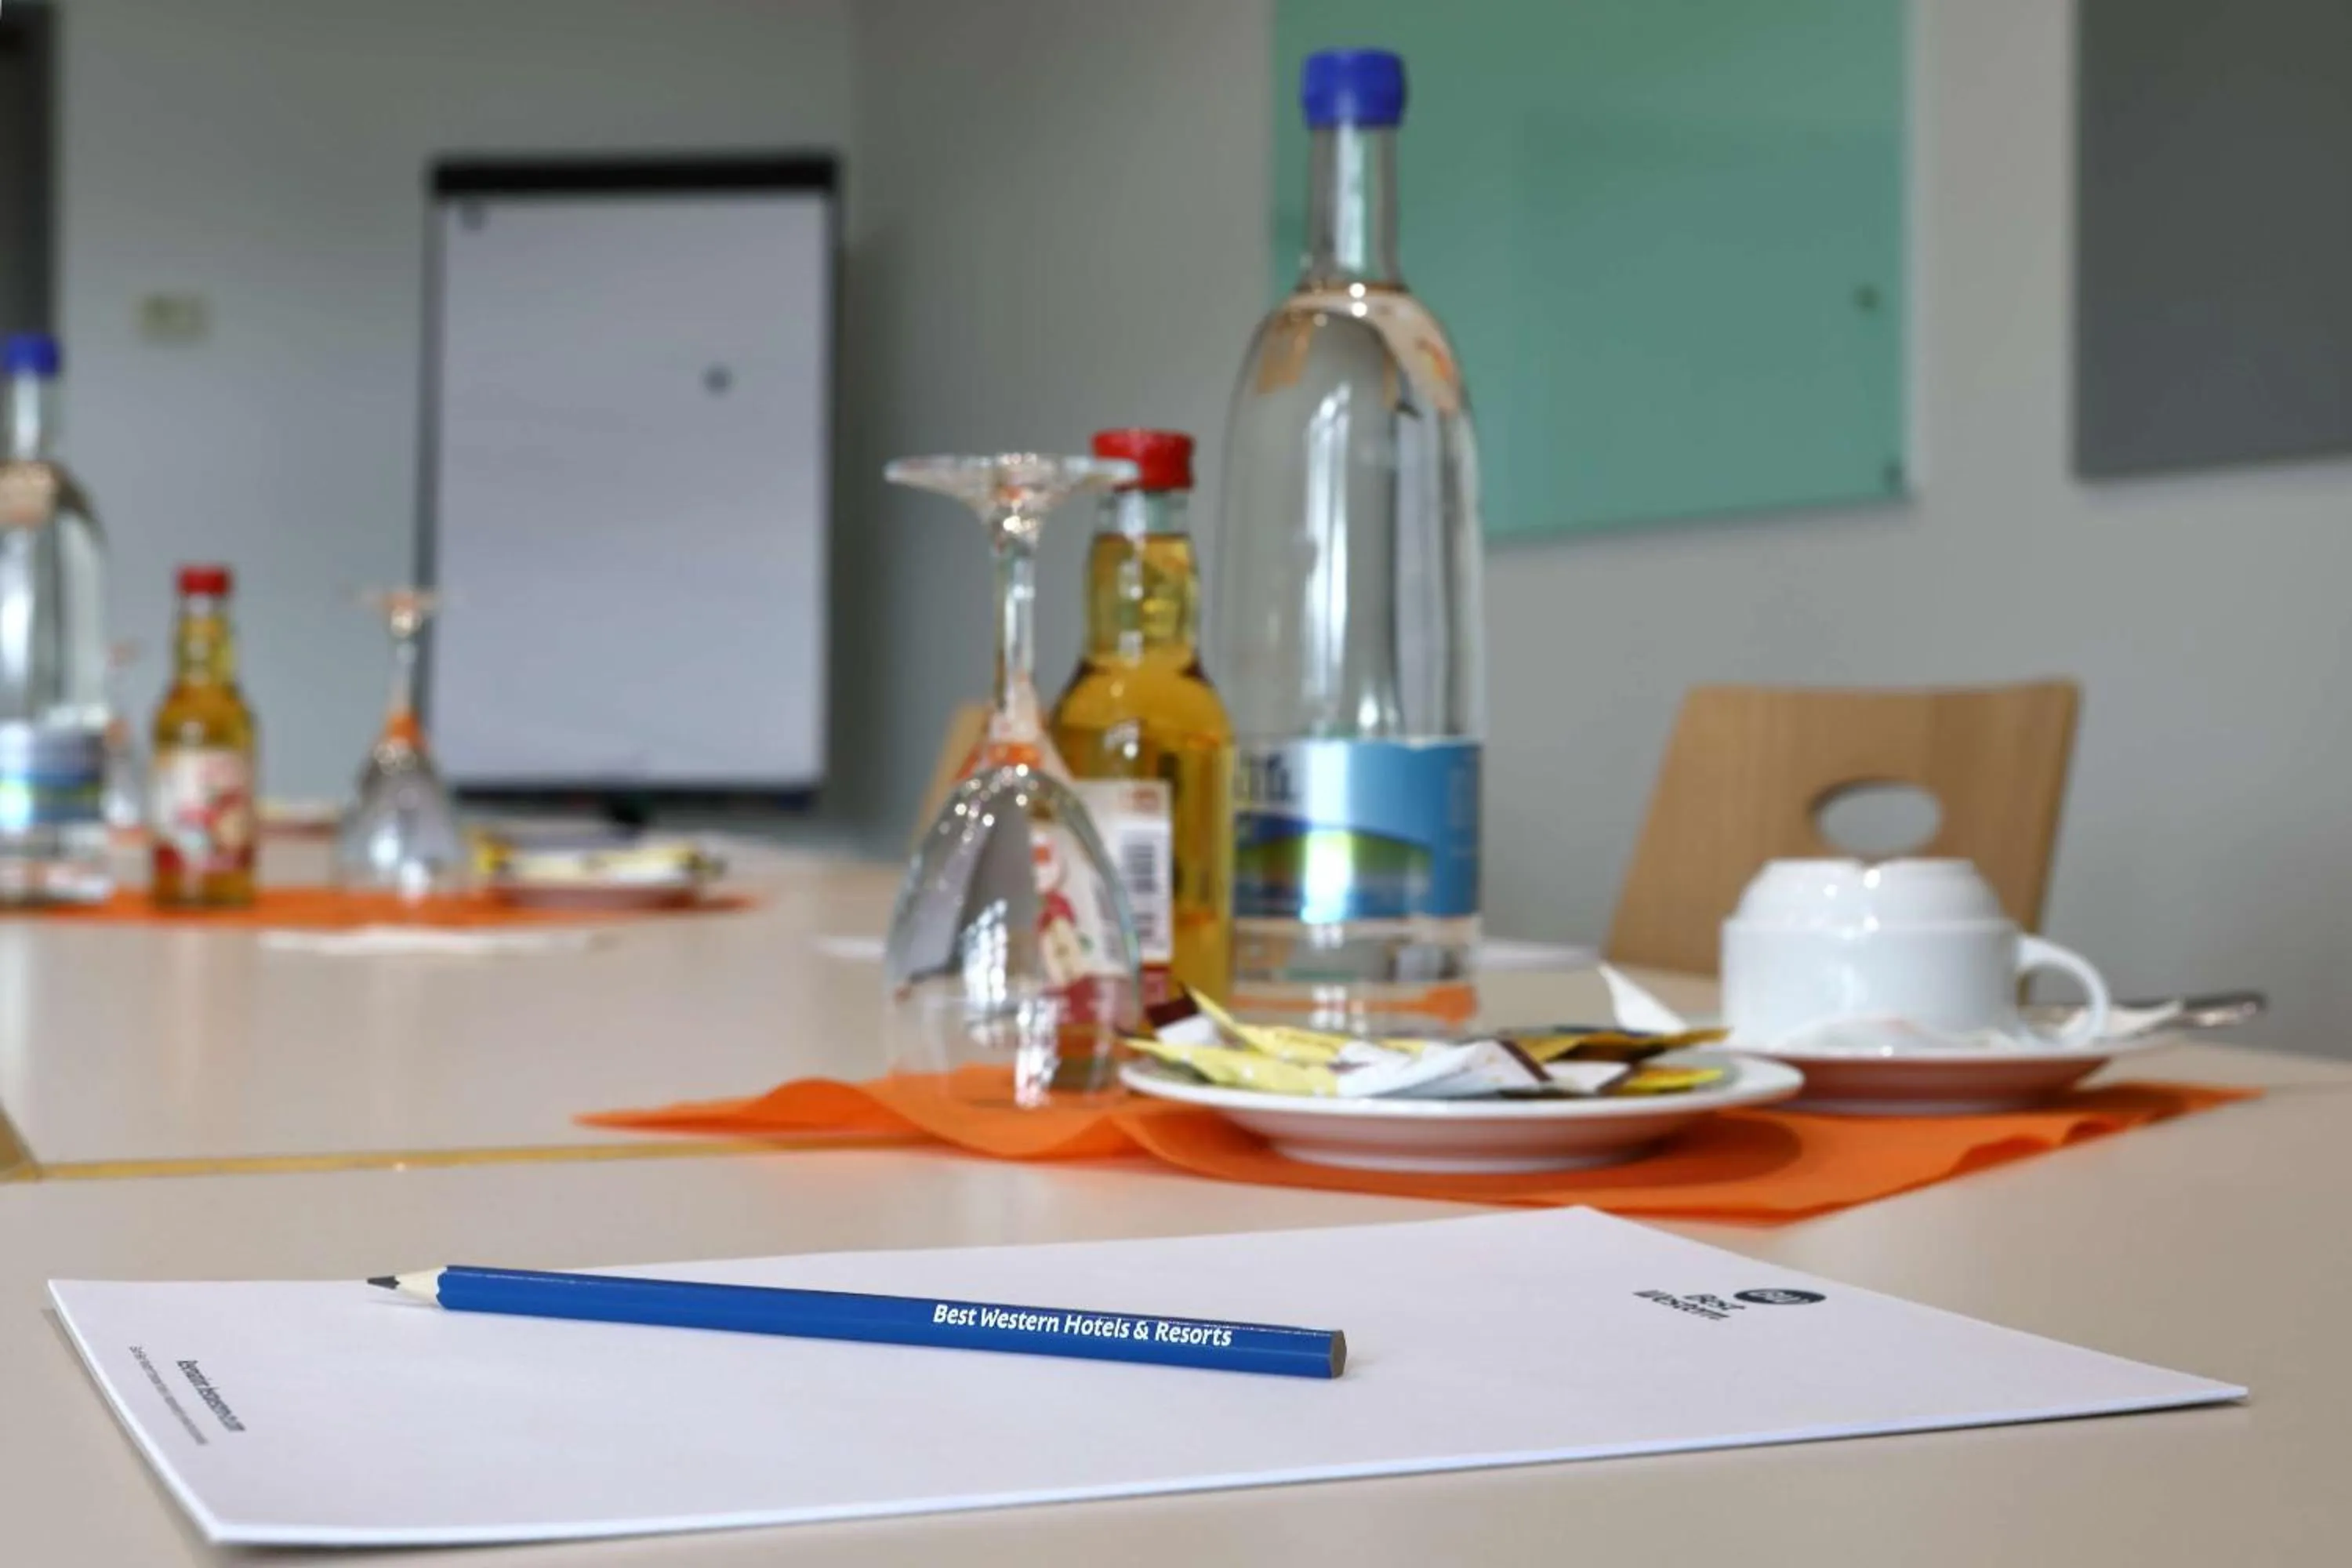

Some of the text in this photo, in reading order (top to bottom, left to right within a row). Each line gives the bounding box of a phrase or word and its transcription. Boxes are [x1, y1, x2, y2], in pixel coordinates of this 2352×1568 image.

[933, 1303, 1233, 1347] Best Western Hotels & Resorts
